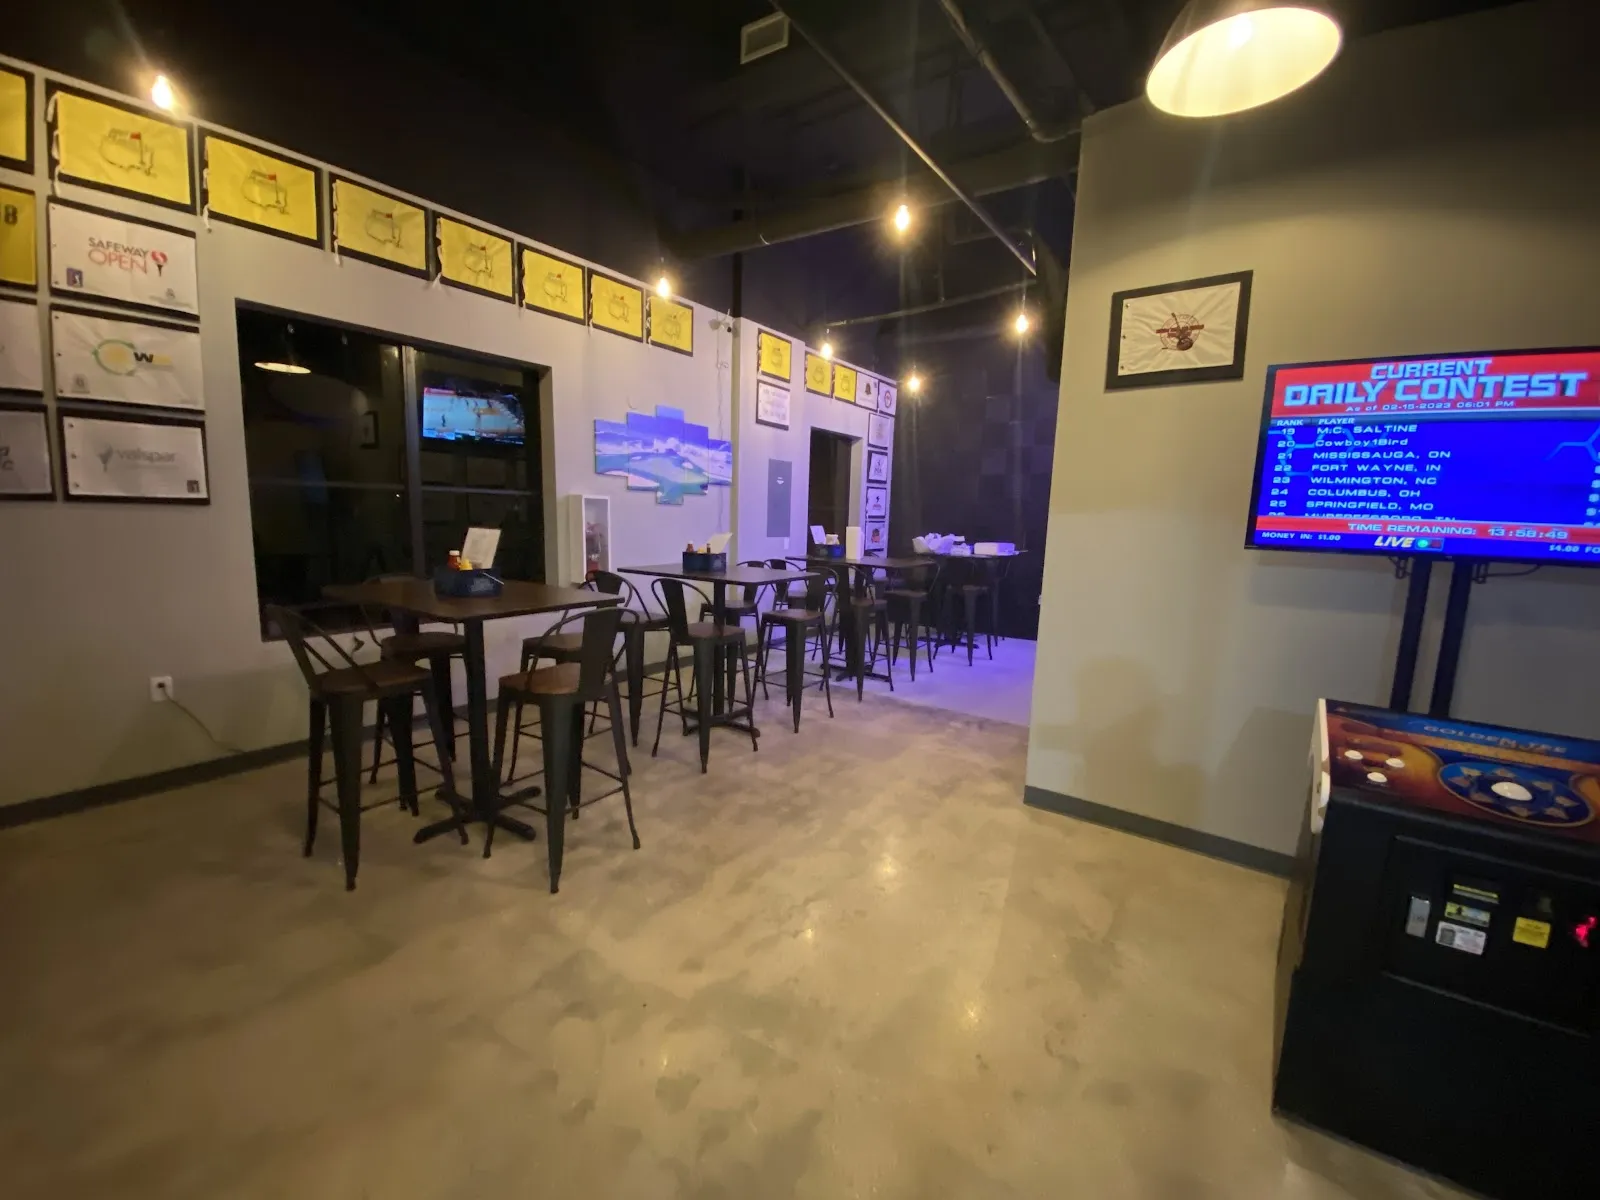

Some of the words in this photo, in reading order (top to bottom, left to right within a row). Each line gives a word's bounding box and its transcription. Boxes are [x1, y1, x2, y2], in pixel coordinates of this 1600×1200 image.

[88, 237, 149, 258] SAFEWAY
[88, 247, 148, 275] OPEN
[1371, 359, 1492, 380] CURRENT
[1284, 381, 1388, 407] DAILY
[1394, 372, 1588, 401] CONTEST
[1382, 402, 1451, 411] 02-15-2023
[1456, 400, 1490, 408] 06:01
[1495, 400, 1514, 408] PM
[1276, 419, 1304, 427] RANK
[1318, 417, 1356, 426] PLAYER
[1353, 424, 1418, 434] SALTINE
[1277, 440, 1295, 448] 20
[1313, 451, 1420, 460] MISSISSAUGA,
[1428, 451, 1451, 459] ON
[1311, 464, 1349, 472] FORT
[1356, 464, 1418, 473] WAYNE,
[1426, 464, 1441, 472] IN
[1310, 476, 1408, 486] WILMINGTON,
[1415, 477, 1437, 485] NC
[1270, 488, 1289, 496] 24
[1307, 489, 1392, 498] COLUMBUS,
[1398, 489, 1421, 497] OH
[1269, 500, 1287, 508] 25
[1306, 501, 1402, 511] SPRINGFIELD,
[1409, 503, 1434, 511] MO
[1348, 523, 1383, 531] TIME
[1387, 524, 1477, 536] REMAINING:
[1374, 535, 1416, 549] LIVE
